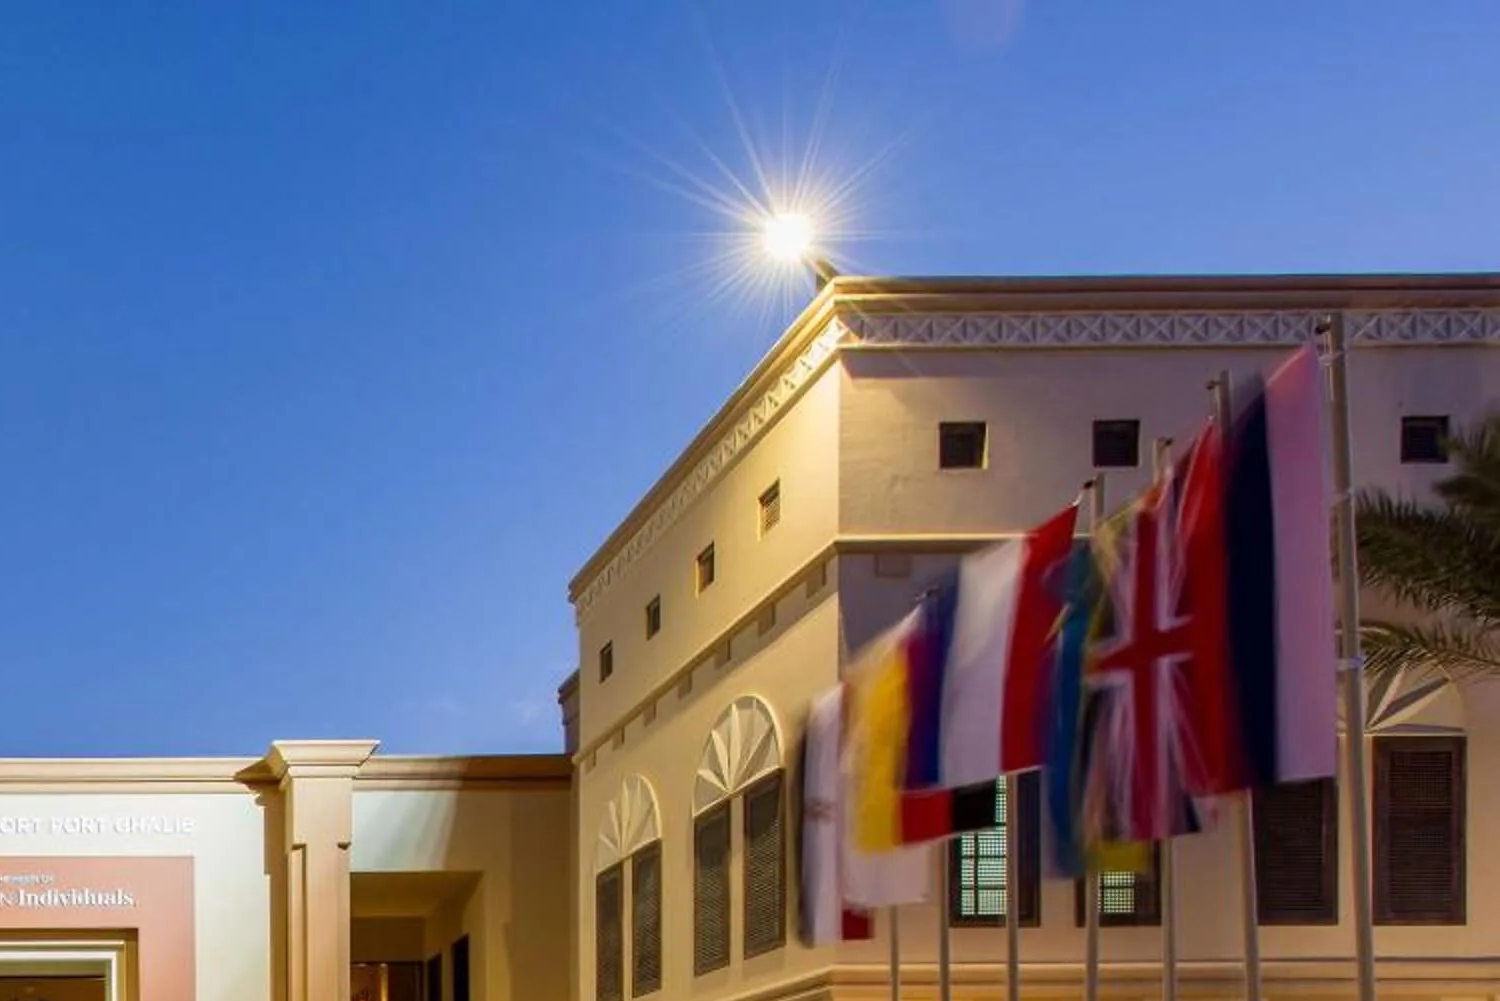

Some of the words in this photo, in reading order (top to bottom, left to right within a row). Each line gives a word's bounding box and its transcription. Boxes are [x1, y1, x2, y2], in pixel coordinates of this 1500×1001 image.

[51, 816, 104, 835] PORT
[113, 816, 196, 835] GHALIB
[17, 887, 133, 906] Individuals
